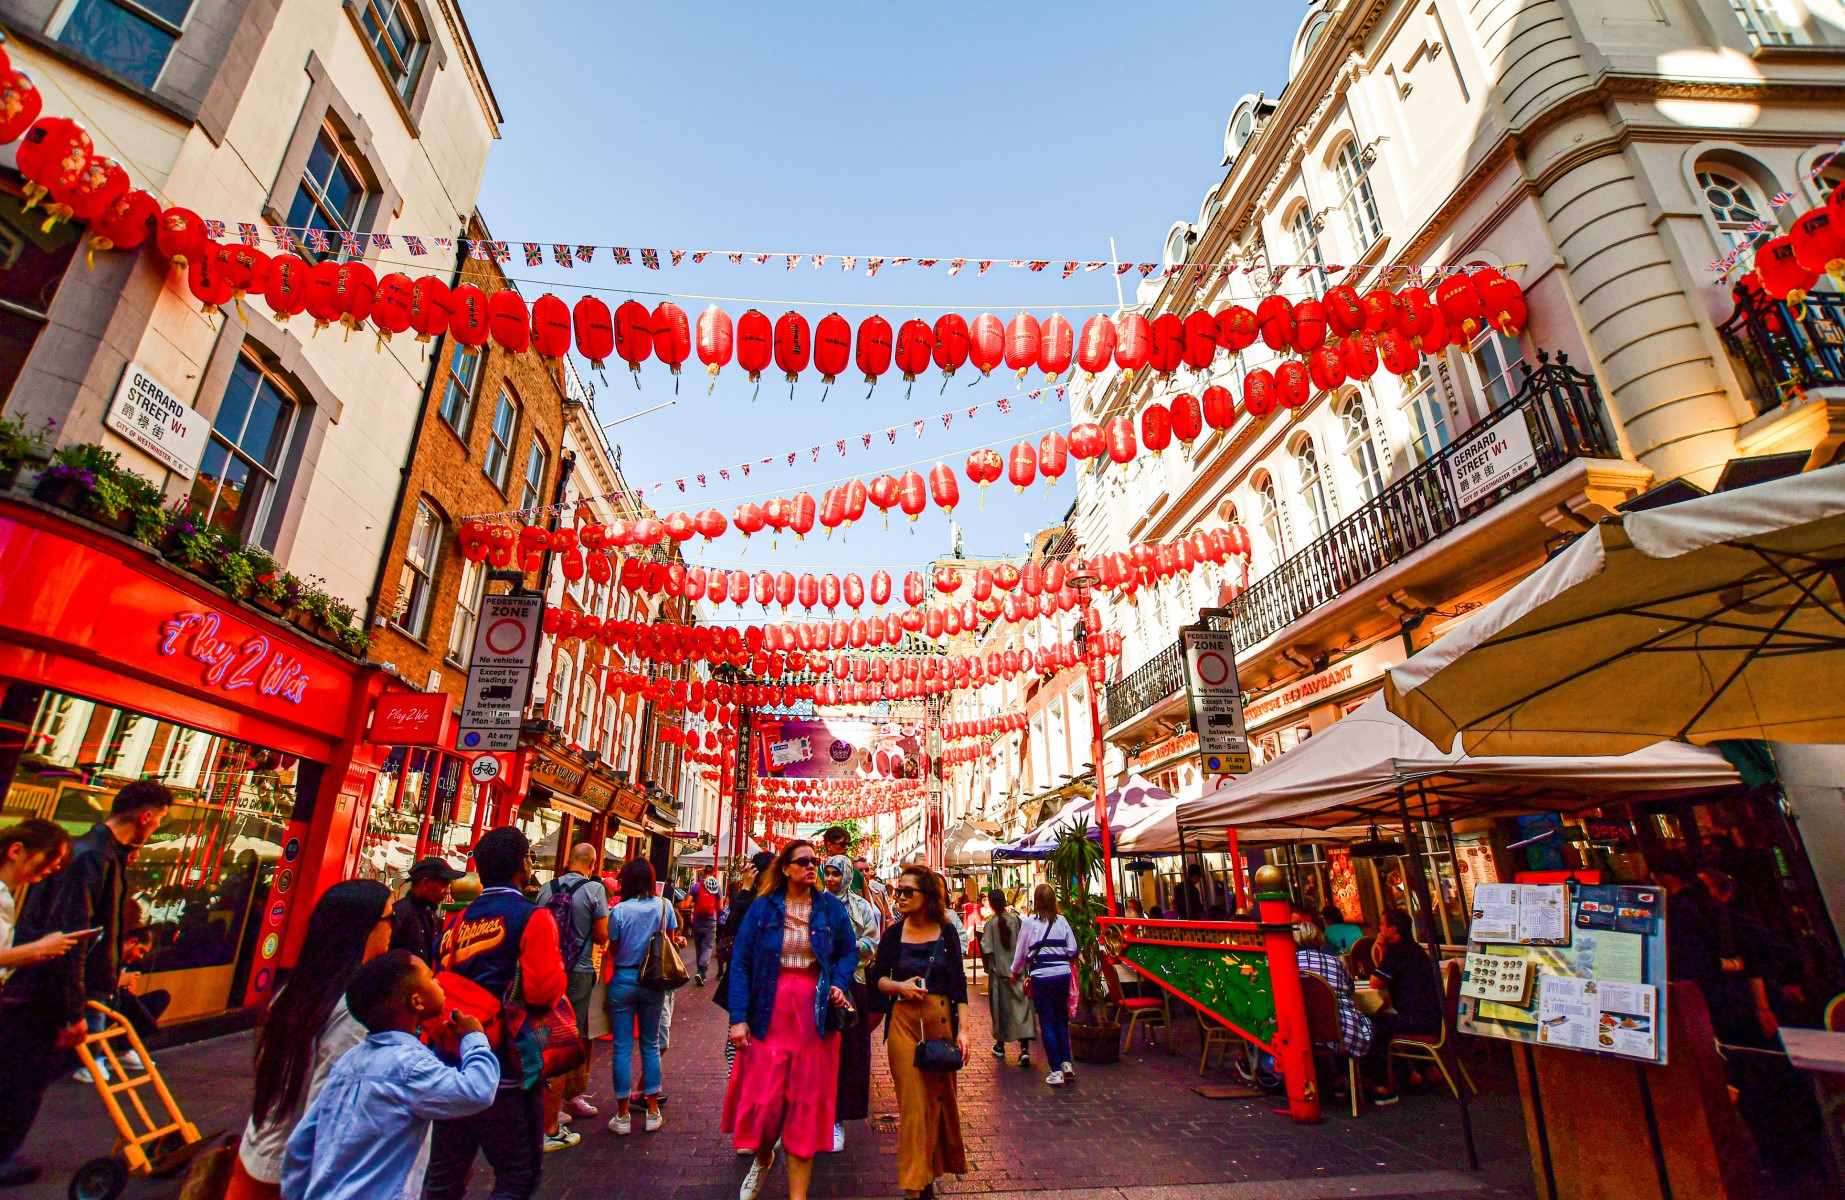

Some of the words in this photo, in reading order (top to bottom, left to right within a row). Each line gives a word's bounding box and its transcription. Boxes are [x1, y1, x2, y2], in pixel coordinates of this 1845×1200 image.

[133, 373, 184, 418] GERRARD
[127, 388, 170, 424] STREET
[171, 418, 188, 439] W1
[116, 420, 128, 433] CITY
[137, 434, 171, 462] WESTMINSTER
[1454, 431, 1496, 467] GERRARD
[1456, 450, 1490, 480] STREET
[1491, 439, 1508, 457] W1
[1463, 493, 1474, 504] CITY
[1479, 471, 1511, 496] WESTMINSTER
[486, 597, 538, 607] PEDESTRIAN
[491, 606, 529, 618] ZONE
[1187, 632, 1230, 641] PEDESTRIAN
[1194, 641, 1225, 651] ZONE
[163, 612, 236, 685] Play
[226, 636, 269, 690] 2
[261, 652, 309, 704] Win
[479, 656, 492, 664] No
[493, 656, 524, 665] vehicles
[479, 669, 506, 678] Except
[508, 669, 520, 677] for
[478, 677, 507, 686] loading
[508, 677, 518, 686] by
[1283, 663, 1353, 705] RESTAURANT
[477, 701, 511, 709] between
[466, 709, 484, 718] 7am
[472, 718, 488, 726] Mon
[495, 718, 511, 726] Sun
[487, 732, 498, 740] At
[499, 733, 513, 742] any
[490, 740, 508, 748] time
[438, 776, 457, 792] CLUB
[439, 919, 501, 955] Phlippines
